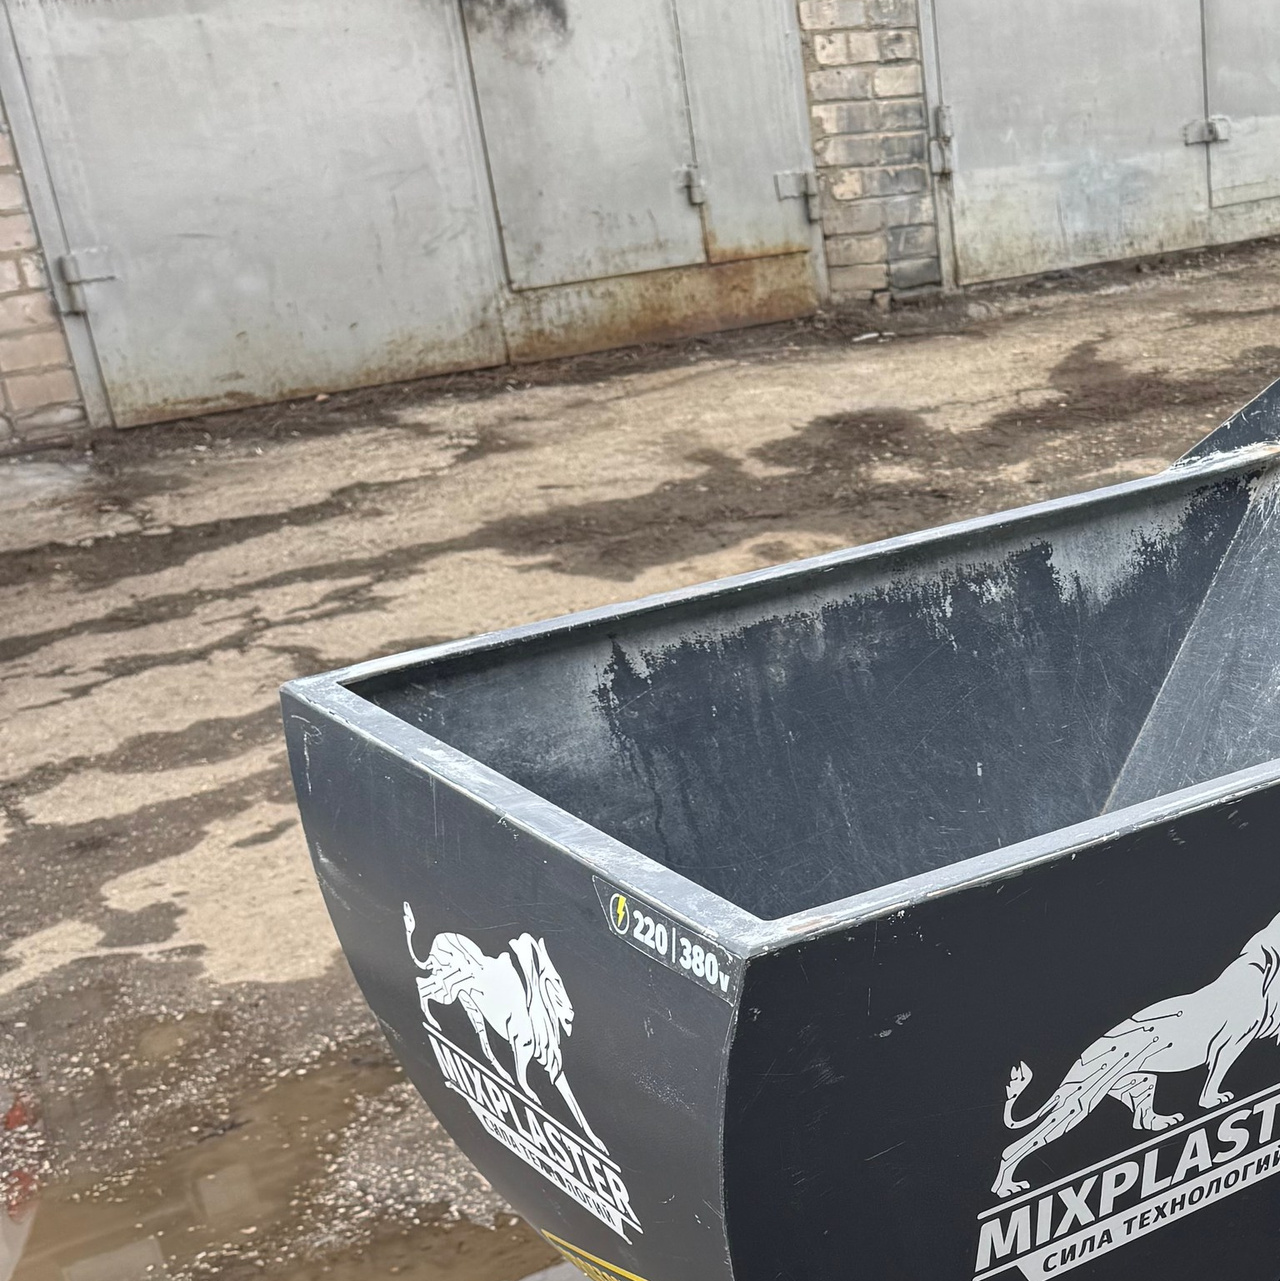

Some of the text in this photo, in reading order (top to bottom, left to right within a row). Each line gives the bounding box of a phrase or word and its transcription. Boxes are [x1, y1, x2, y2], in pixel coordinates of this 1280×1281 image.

[633, 909, 668, 955] 220
[428, 1034, 642, 1226] MIXPLASTER
[482, 1114, 520, 1152] СИЛА
[1042, 1229, 1113, 1274] СИЛА
